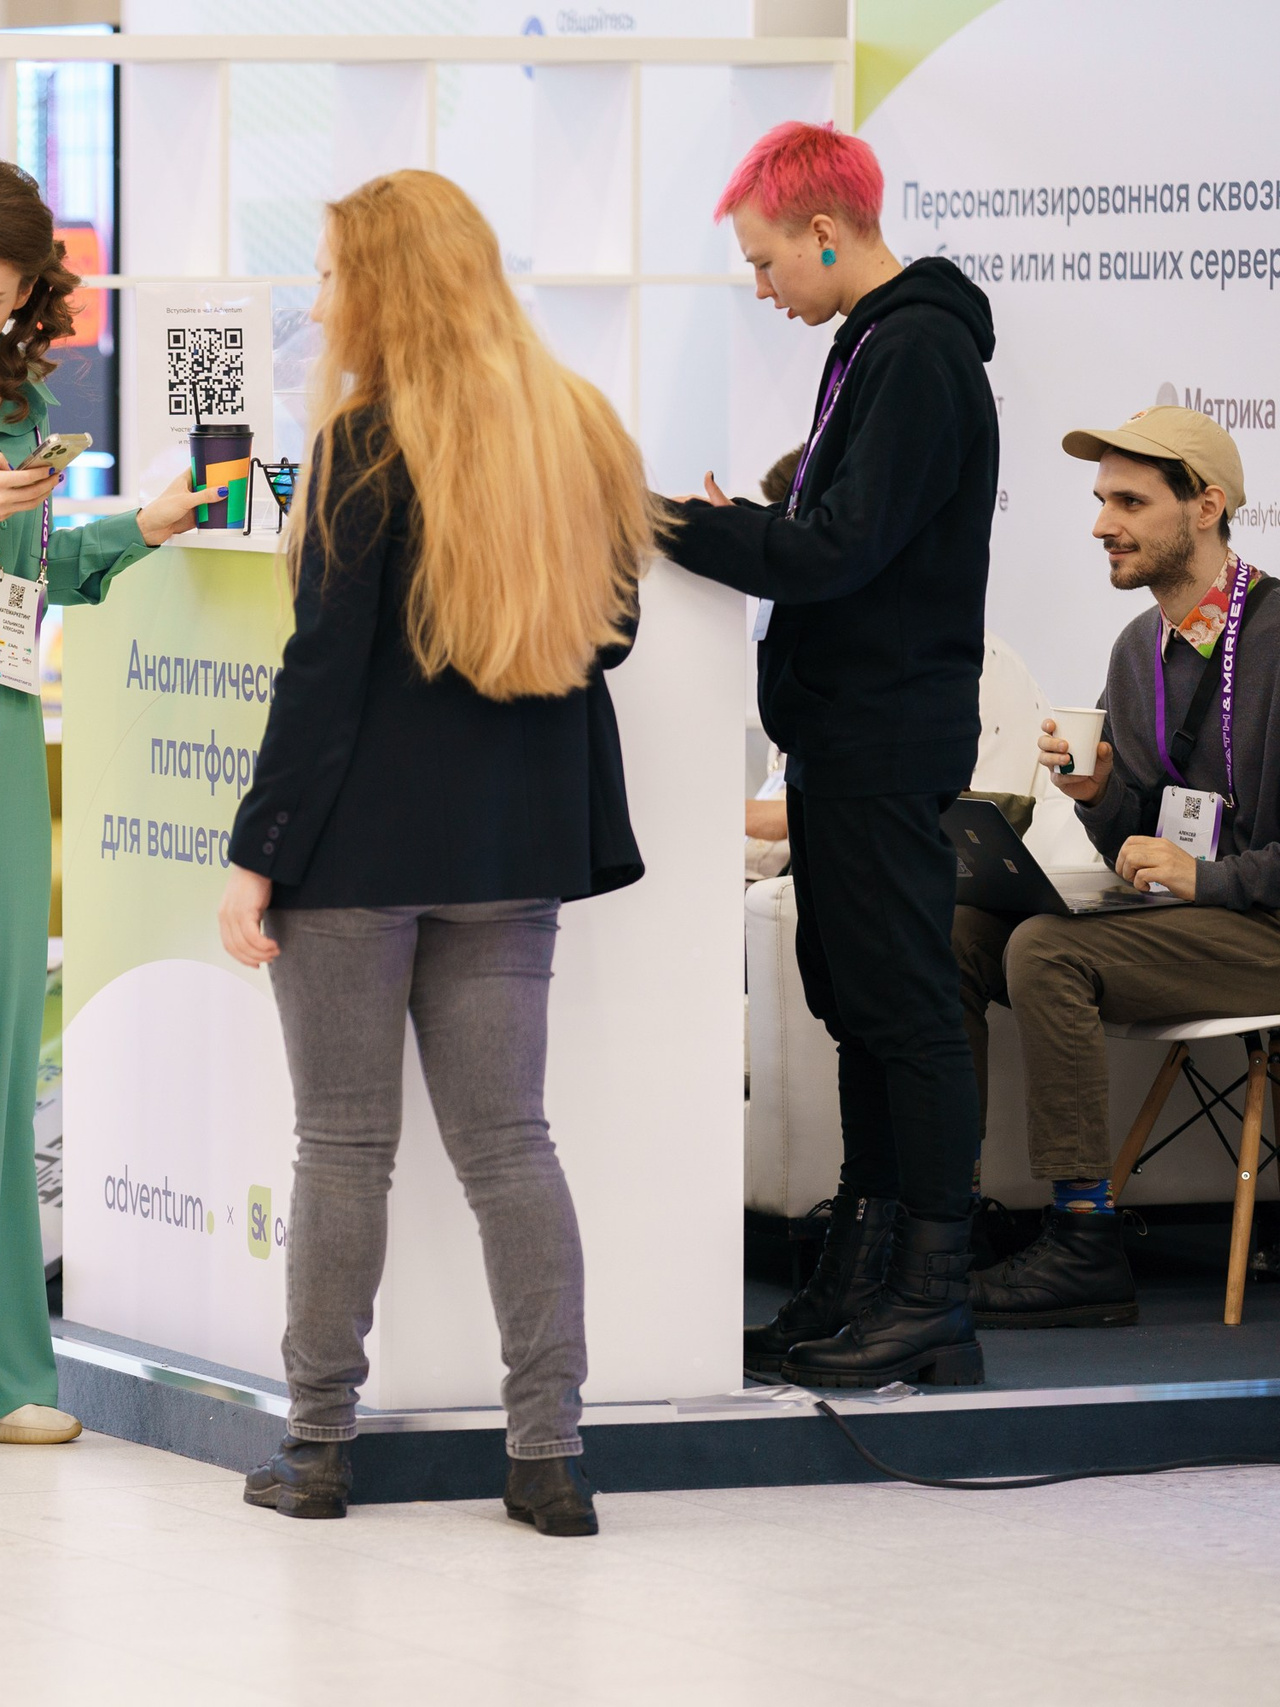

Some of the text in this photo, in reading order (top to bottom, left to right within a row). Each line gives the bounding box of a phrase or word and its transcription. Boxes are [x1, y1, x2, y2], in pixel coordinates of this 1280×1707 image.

[903, 180, 1280, 230] Персонализированная сквоз
[1011, 252, 1054, 282] или
[1062, 251, 1091, 282] на
[1099, 250, 1184, 281] ваших
[166, 307, 196, 315] Вступайте
[1231, 501, 1280, 535] Analyti
[150, 728, 258, 800] платфор
[101, 813, 232, 868] для вашего
